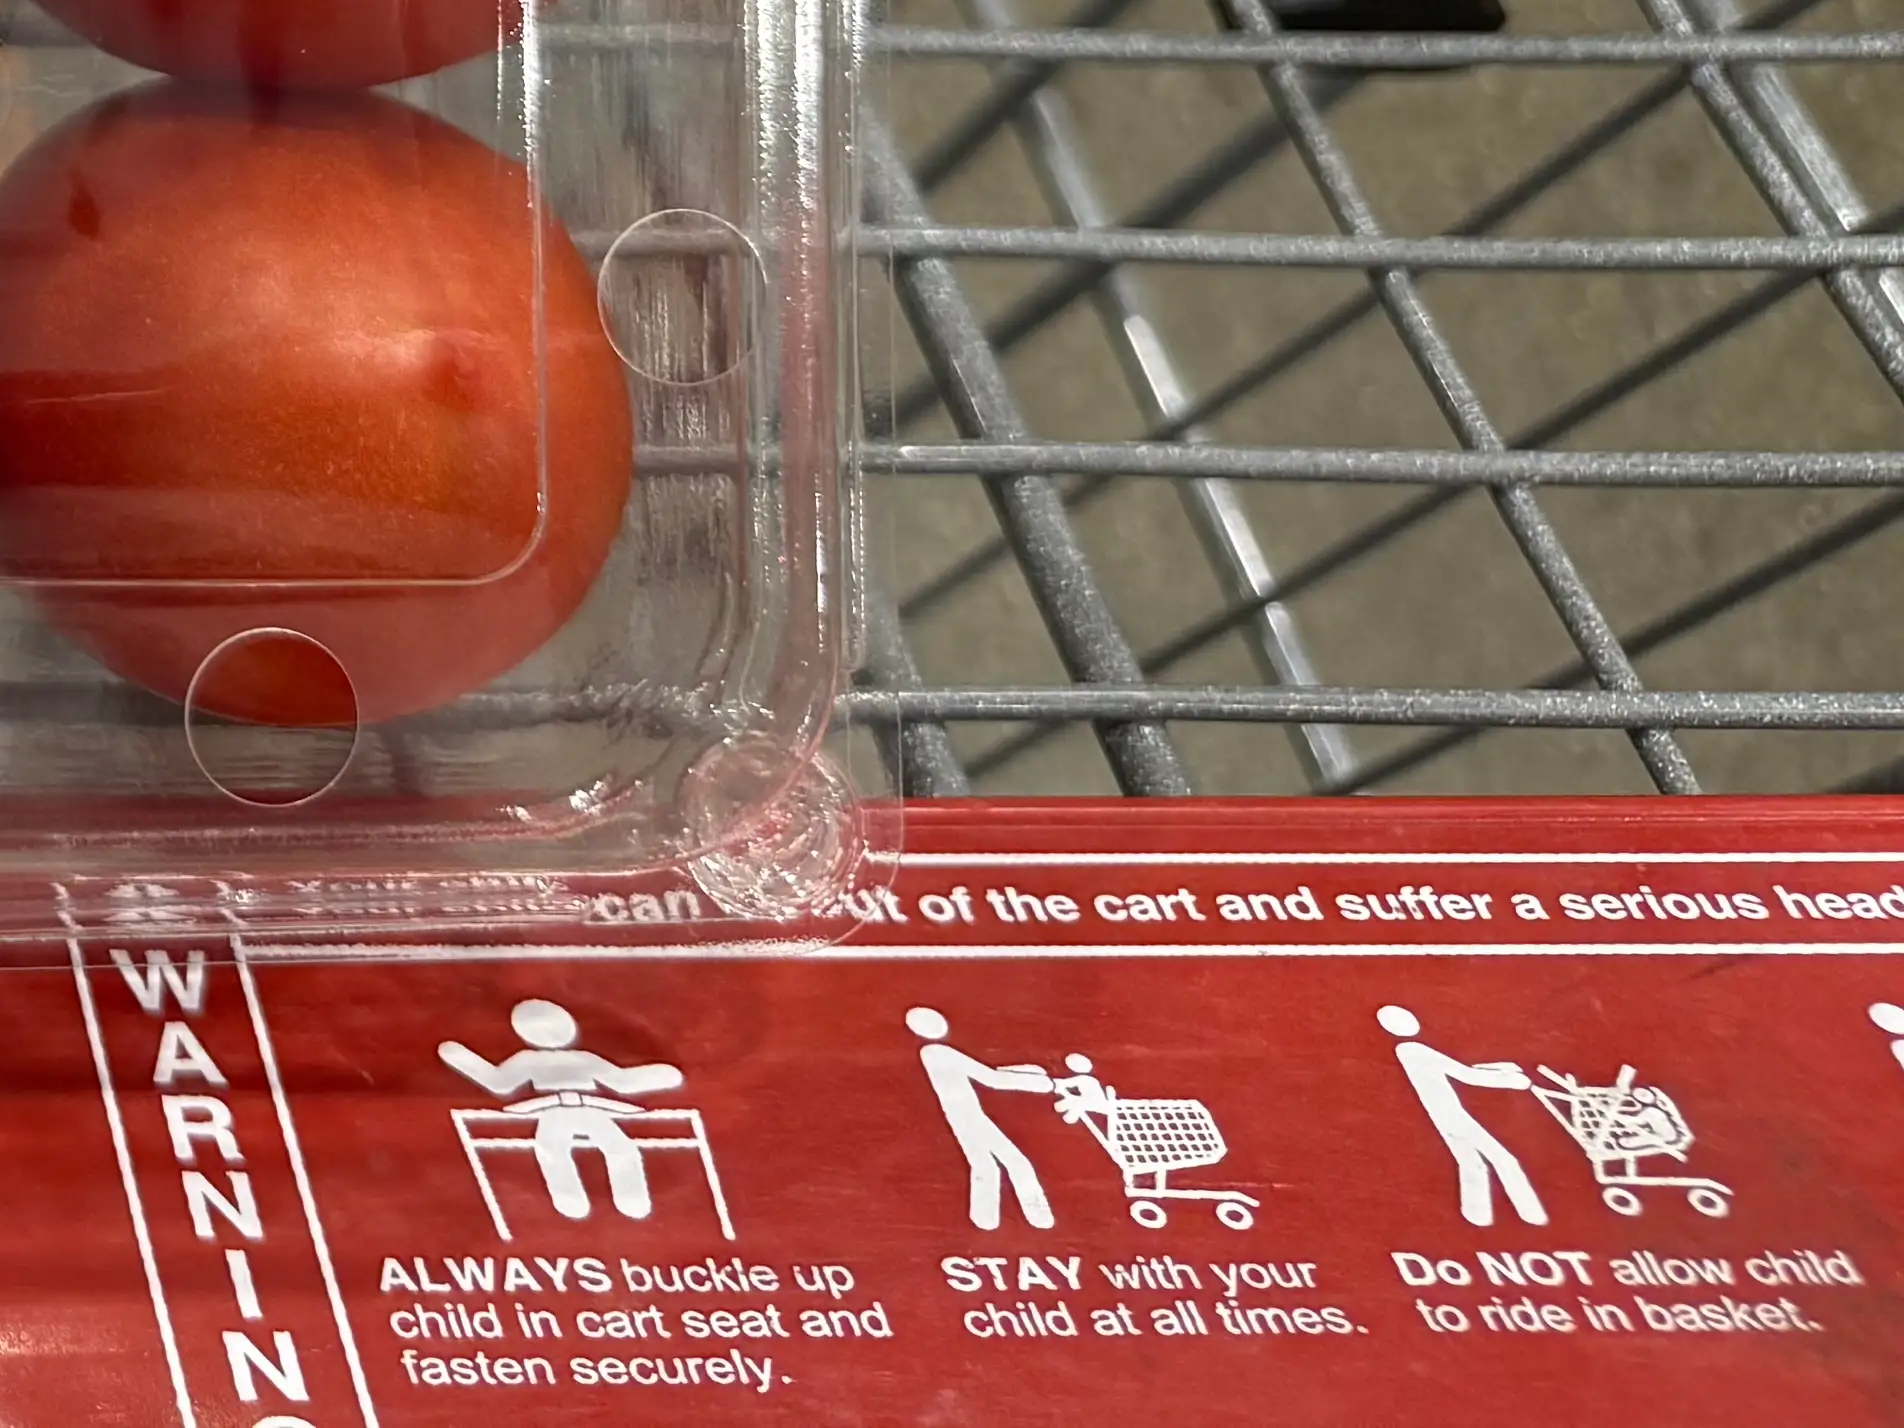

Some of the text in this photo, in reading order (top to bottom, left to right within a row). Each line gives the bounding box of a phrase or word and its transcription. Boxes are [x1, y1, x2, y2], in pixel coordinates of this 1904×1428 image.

[919, 887, 974, 922] of
[986, 887, 1080, 922] the
[1095, 888, 1204, 922] cart
[1216, 887, 1324, 921] and
[1336, 886, 1492, 920] suffer
[1511, 894, 1549, 920] a
[1560, 886, 1769, 920] serious
[381, 1257, 854, 1299] ALWAYS buckle up
[941, 1256, 1316, 1300] STAY with your
[1391, 1250, 1862, 1285] Do NOT allow child
[390, 1302, 893, 1338] child in cart seat and
[964, 1300, 1368, 1337] child at all times.
[1416, 1296, 1821, 1332] to ride in basket.
[401, 1349, 792, 1393] fasten securely.
